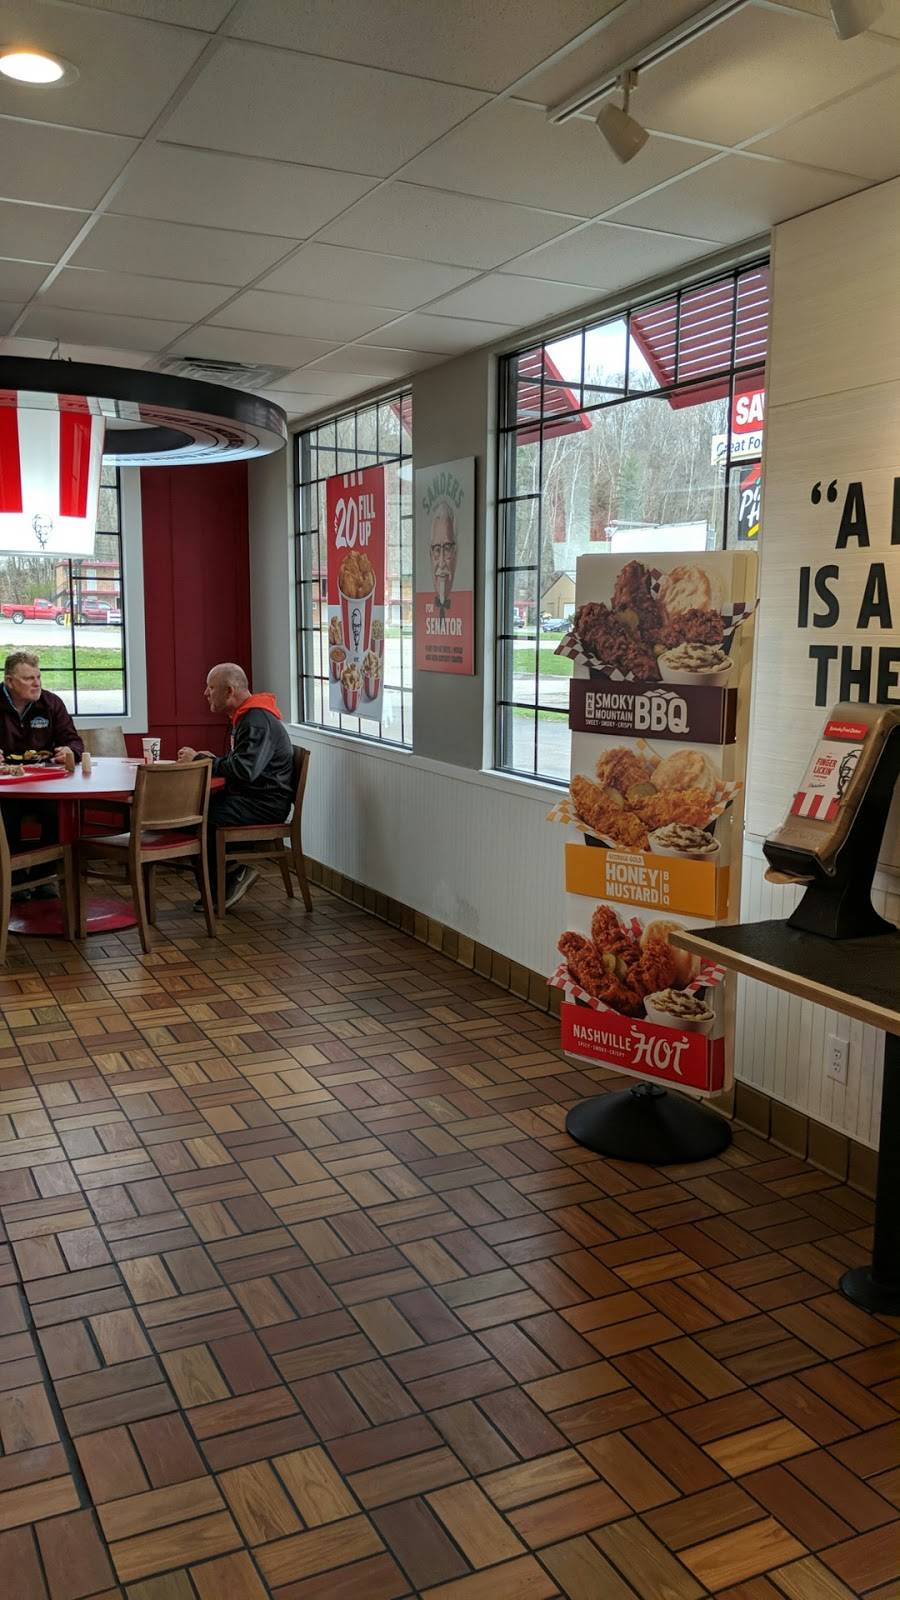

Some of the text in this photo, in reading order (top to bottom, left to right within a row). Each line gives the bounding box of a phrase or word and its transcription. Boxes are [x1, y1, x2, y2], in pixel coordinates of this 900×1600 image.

[735, 391, 764, 425] SA
[748, 436, 763, 451] Fo
[423, 472, 465, 515] SANDERS
[358, 493, 376, 521] FILL
[358, 521, 371, 547] UP
[797, 563, 893, 629] IS A
[425, 617, 462, 636] SENATOR
[595, 693, 634, 709] SMOKY
[595, 709, 633, 722] MOUNTAIN
[634, 695, 690, 734] BBQ
[605, 863, 658, 887] HONEY
[606, 881, 658, 903] MUSTARD
[573, 1024, 632, 1052] NASHVILLE
